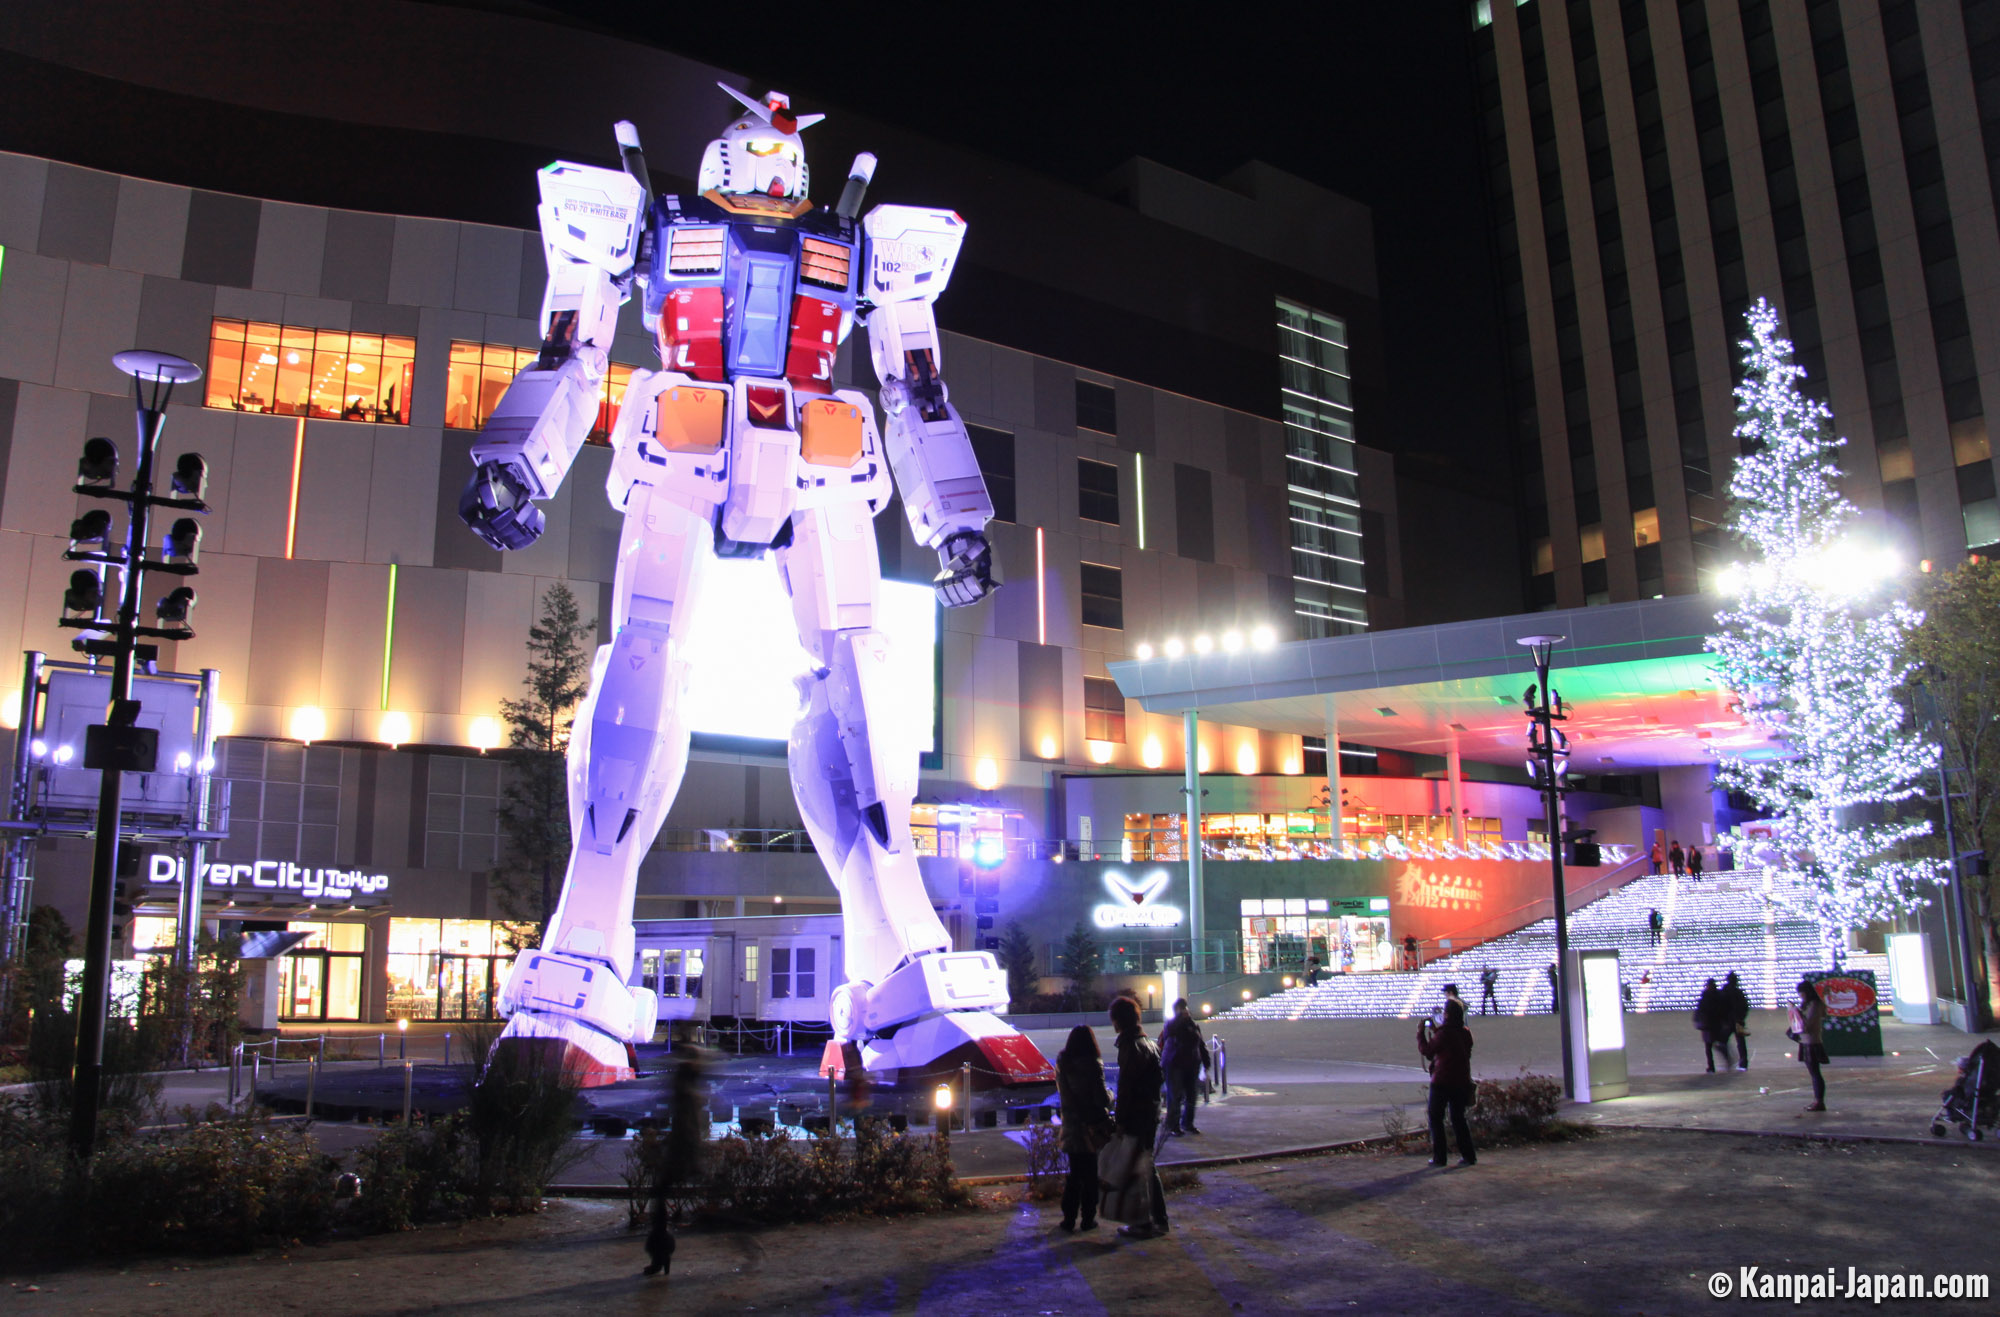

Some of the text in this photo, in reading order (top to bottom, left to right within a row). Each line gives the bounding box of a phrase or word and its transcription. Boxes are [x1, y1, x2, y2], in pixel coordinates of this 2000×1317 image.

[882, 261, 901, 273] 102
[1408, 870, 1484, 901] Christmas
[1408, 894, 1439, 909] 2012
